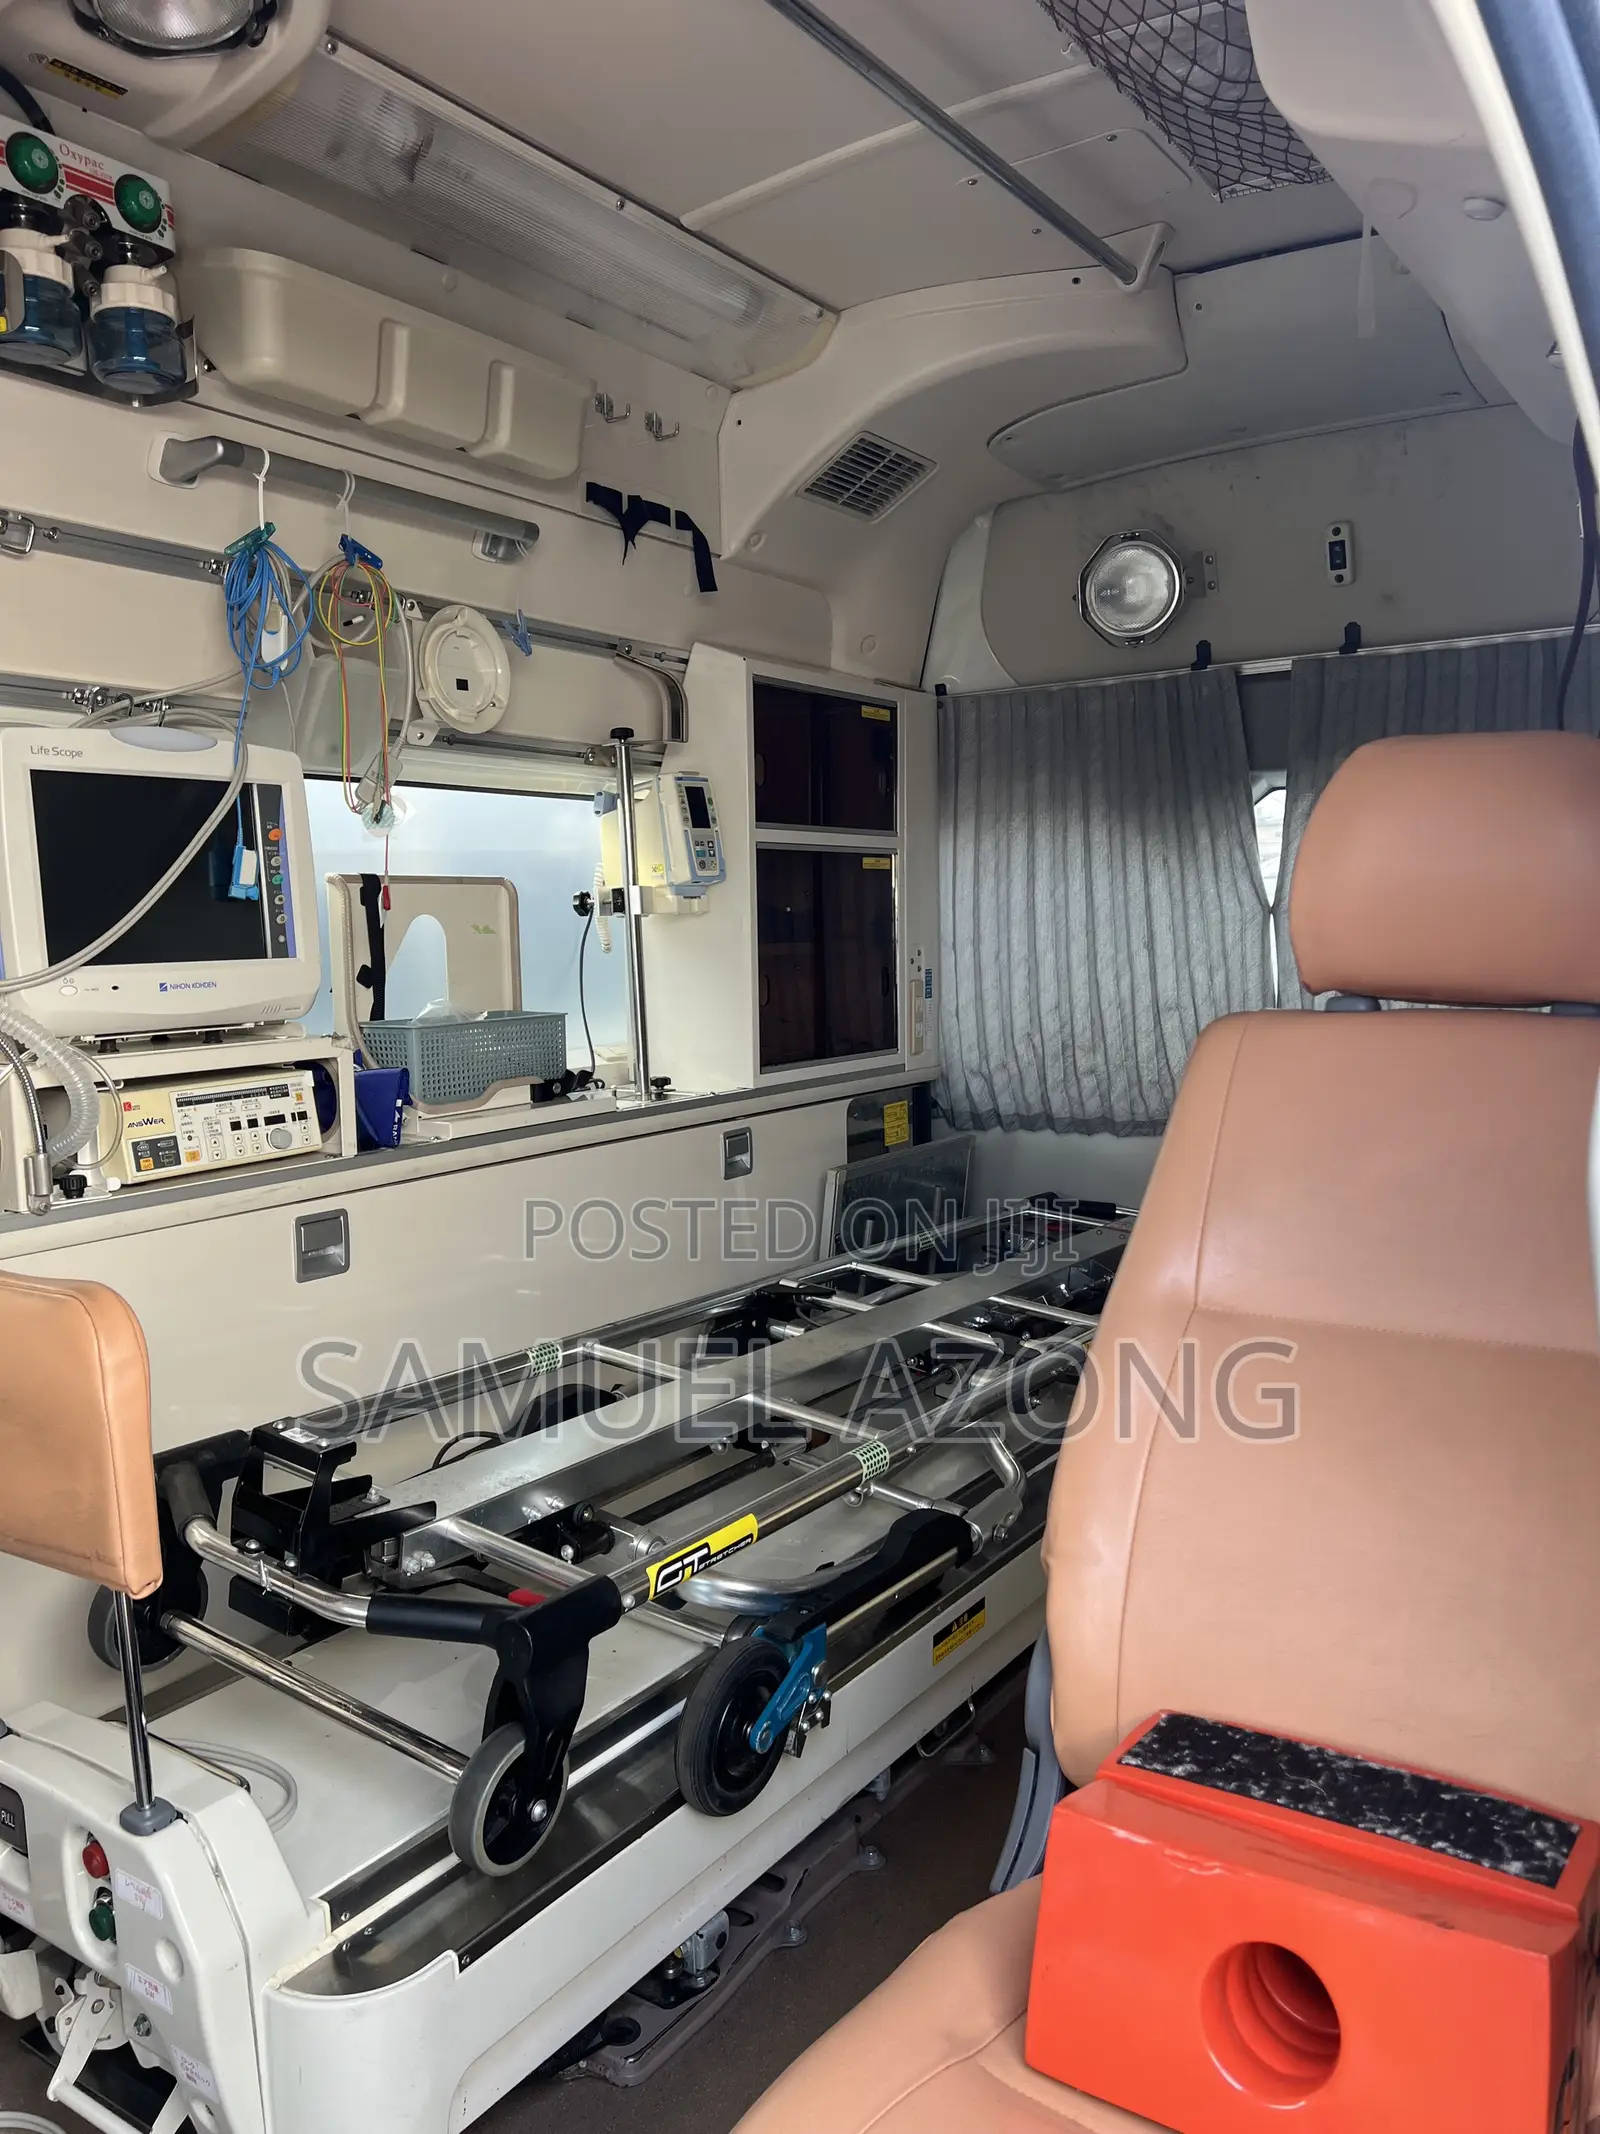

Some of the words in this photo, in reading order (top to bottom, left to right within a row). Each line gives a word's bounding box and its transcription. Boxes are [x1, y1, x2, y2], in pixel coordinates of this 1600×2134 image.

[59, 143, 105, 170] Oxypac
[30, 745, 50, 756] Life
[51, 746, 83, 760] Scope
[169, 982, 191, 990] NIHON
[191, 981, 217, 989] KOHDEN
[1, 1810, 16, 1828] PULL
